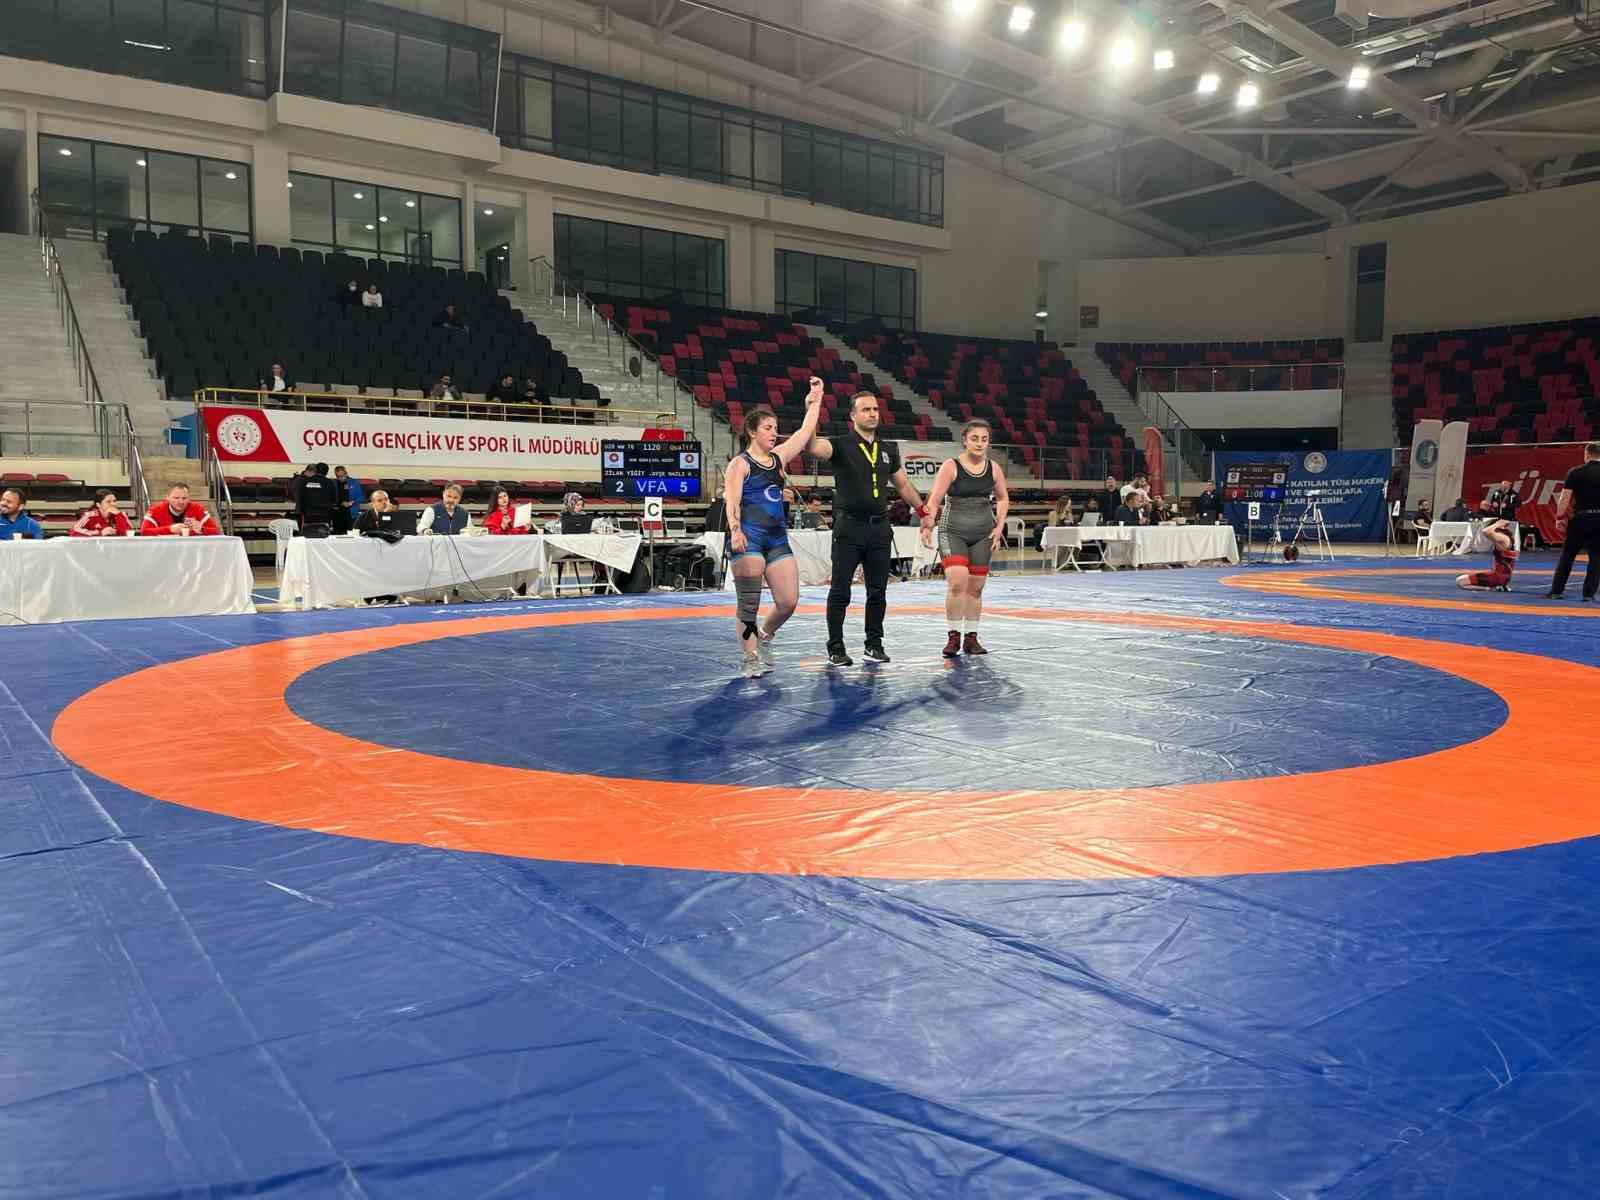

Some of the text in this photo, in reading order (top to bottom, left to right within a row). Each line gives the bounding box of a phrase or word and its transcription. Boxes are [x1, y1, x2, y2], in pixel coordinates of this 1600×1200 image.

[303, 429, 600, 456] ÇORUM GENÇLİK VE SPOR İL MÜDÜRLÜ
[615, 480, 688, 493] 2 VFA 5
[1481, 470, 1566, 505] TÜR
[647, 502, 660, 517] C
[1250, 506, 1259, 516] B
